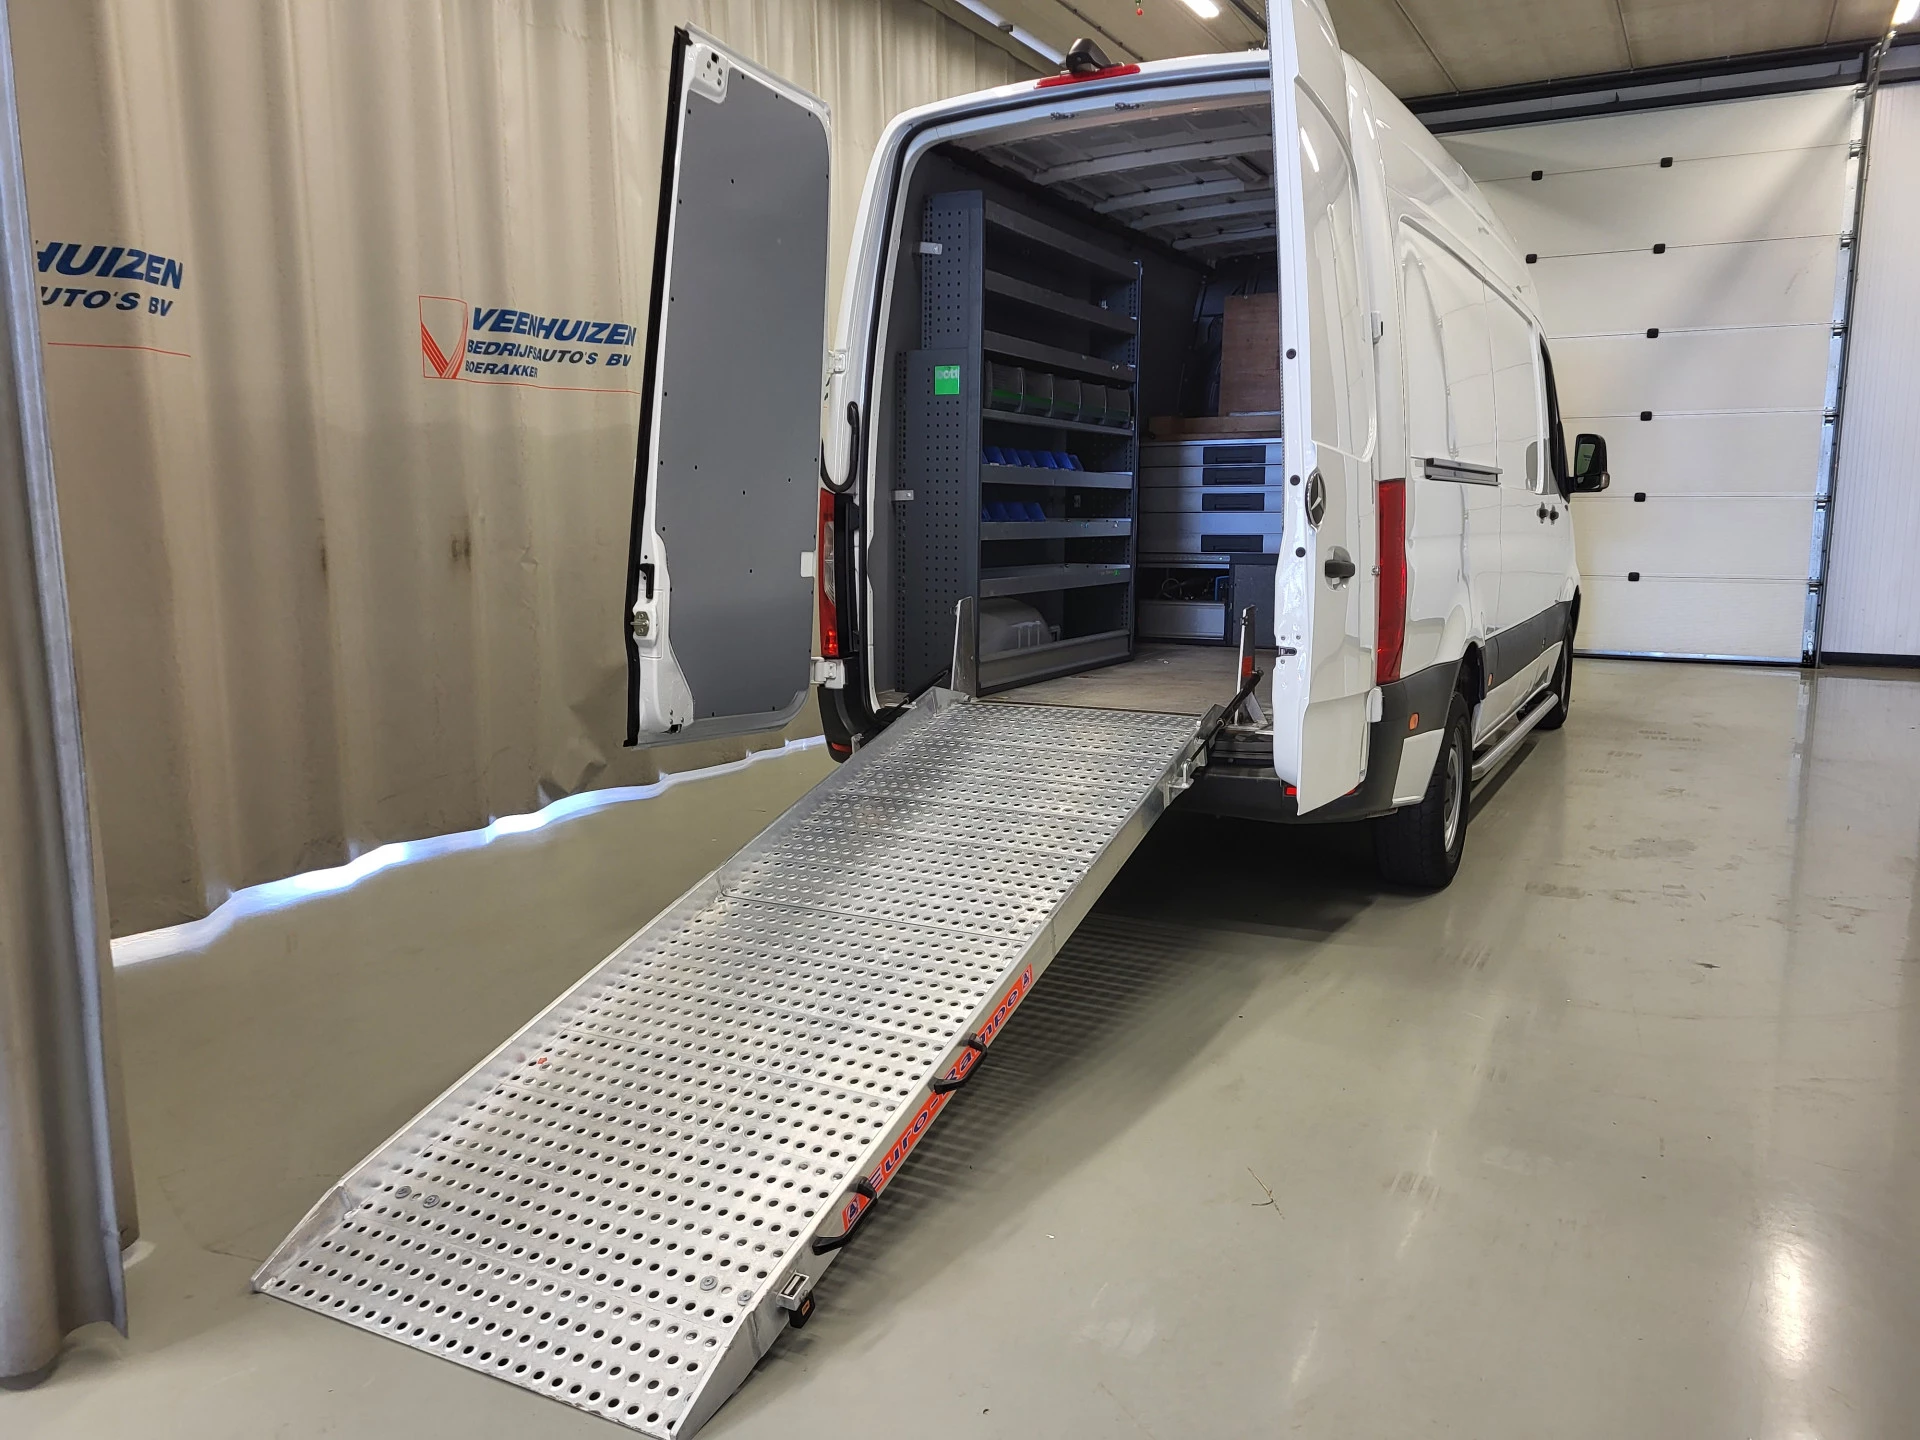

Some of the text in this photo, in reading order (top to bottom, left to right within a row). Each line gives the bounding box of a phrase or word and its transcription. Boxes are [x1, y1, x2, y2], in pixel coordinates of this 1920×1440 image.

[148, 297, 173, 316] BV
[472, 307, 637, 346] VEENHUIZEN
[467, 339, 632, 366] BEDRIJFSAUTO'S BV
[465, 361, 538, 378] BOERAKKER
